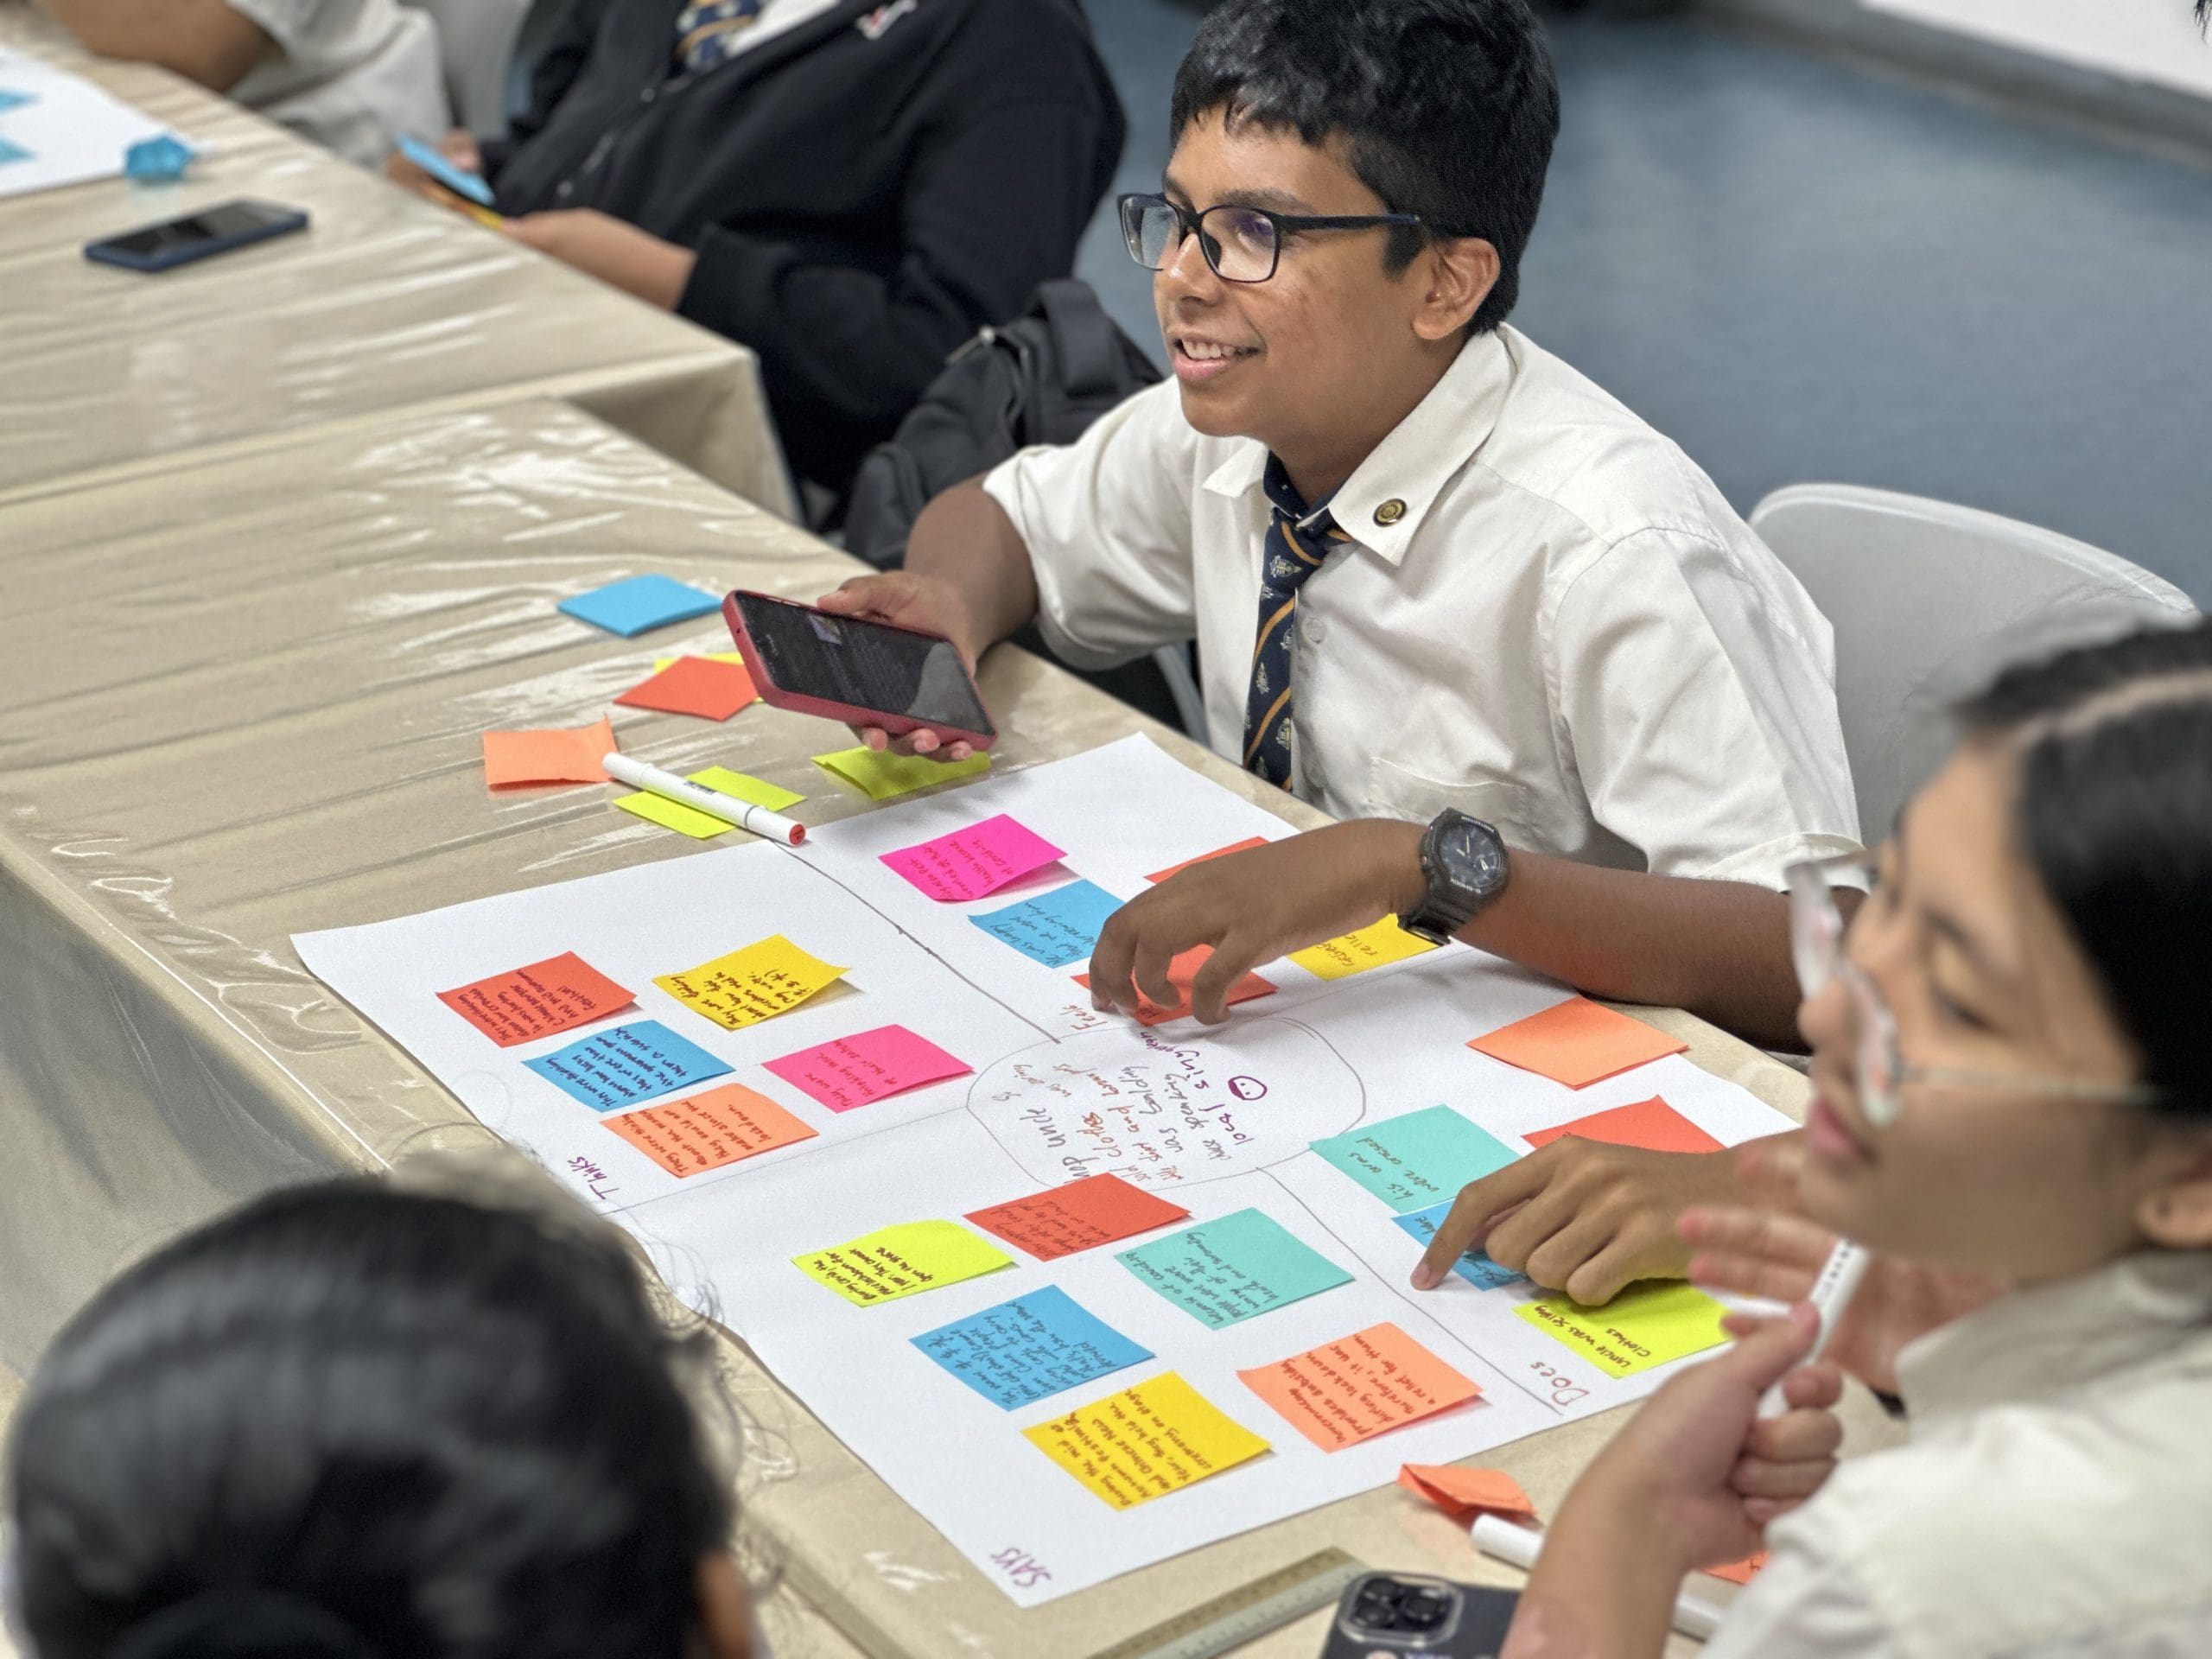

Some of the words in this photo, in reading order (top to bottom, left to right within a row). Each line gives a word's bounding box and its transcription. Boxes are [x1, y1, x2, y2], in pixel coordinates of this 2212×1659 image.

[1060, 1003, 1109, 1033] Feels
[697, 1111, 728, 1130] since
[1109, 1104, 1141, 1133] and
[667, 1128, 683, 1142] the
[679, 1119, 709, 1139] could
[642, 1135, 667, 1153] were
[681, 1144, 708, 1166] about
[1348, 1152, 1382, 1173] arms
[568, 1154, 620, 1201] Thinks
[1386, 1183, 1414, 1200] his
[1567, 1326, 1595, 1345] was
[1529, 1360, 1592, 1408] Does
[1151, 1415, 1165, 1427] on
[1057, 1440, 1080, 1458] mid
[1082, 1459, 1099, 1477] the
